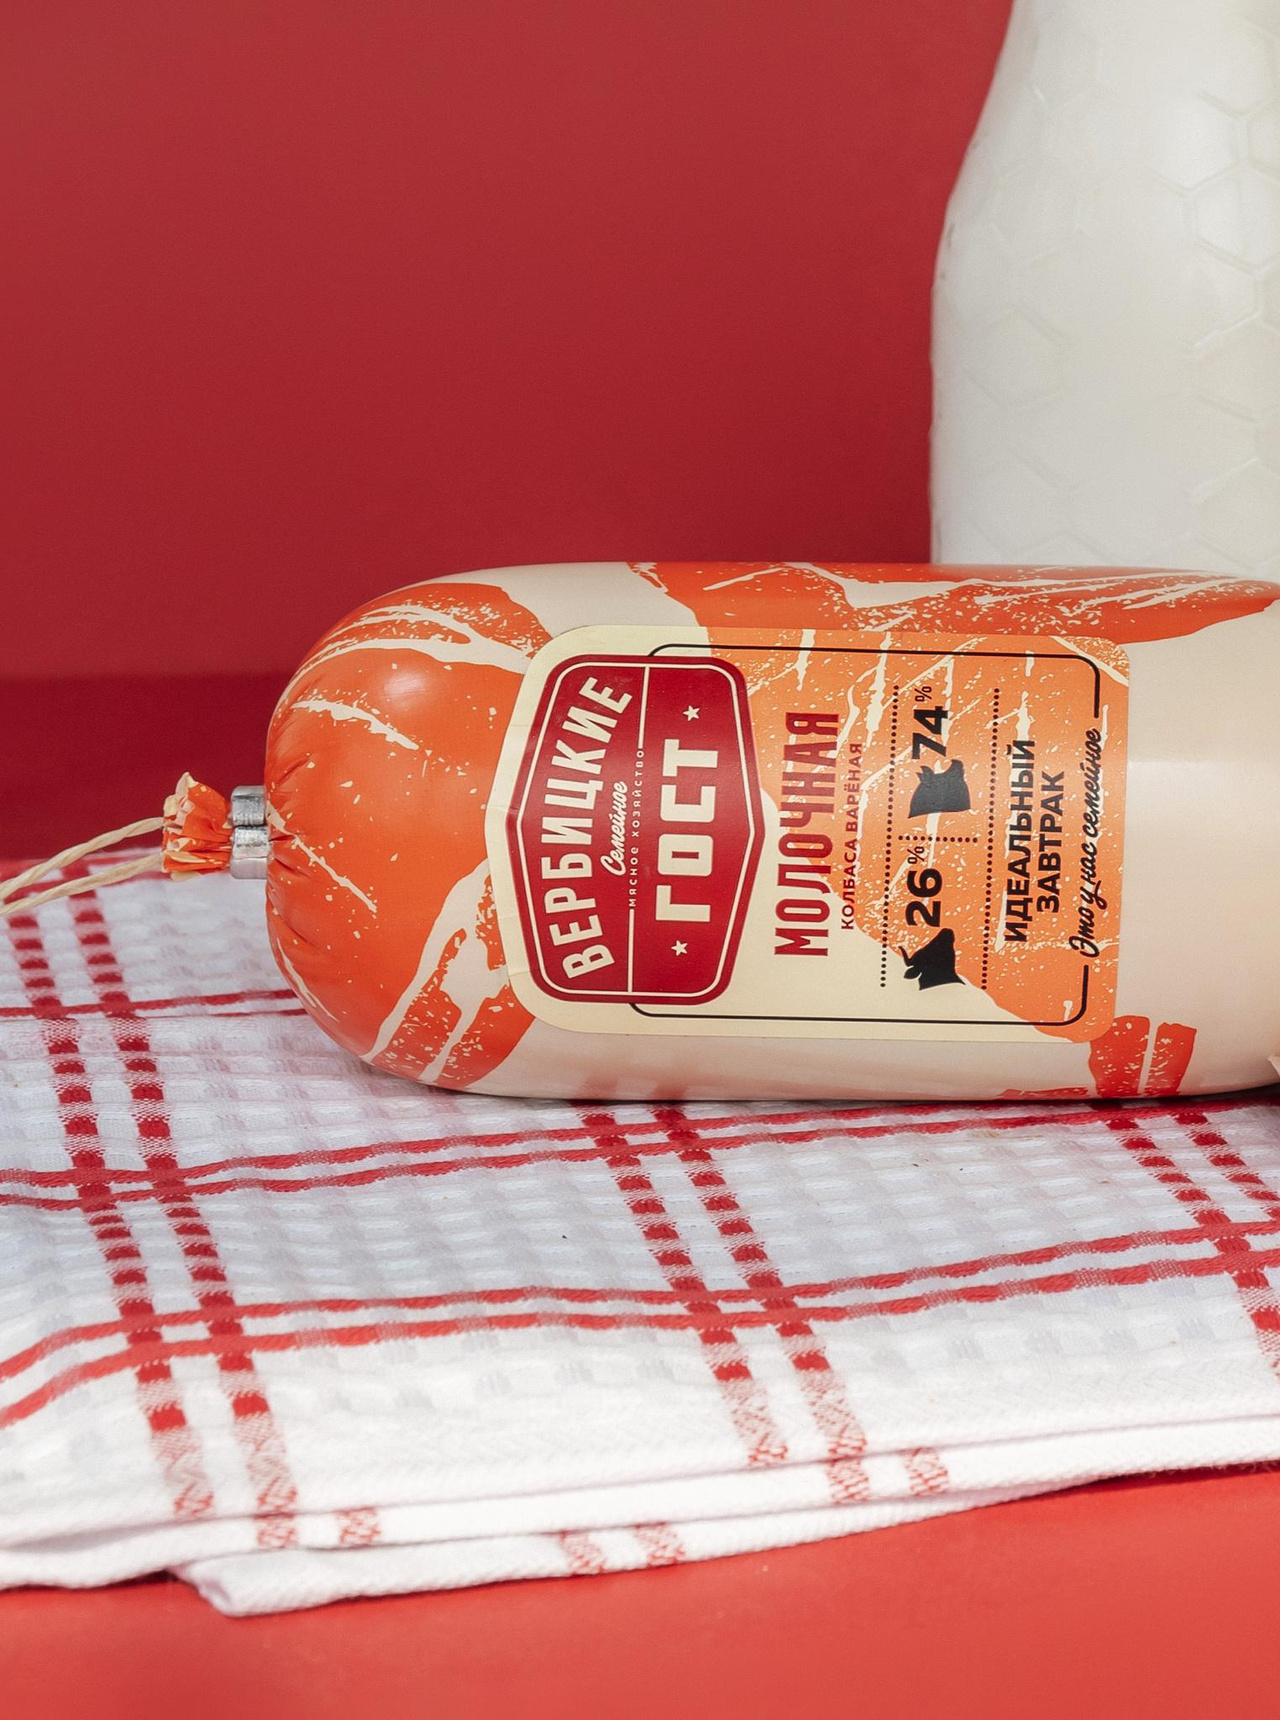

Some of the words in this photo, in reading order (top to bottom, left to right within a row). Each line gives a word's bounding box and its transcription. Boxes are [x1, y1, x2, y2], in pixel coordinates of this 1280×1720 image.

[539, 677, 634, 979] ВЕРБИЦКИЕ
[600, 781, 628, 876] Семейное
[655, 738, 718, 923] ГОСТ
[843, 743, 862, 832] ВАРЁНАЯ
[1080, 729, 1101, 837] семейное
[774, 712, 838, 956] МОЛОЧНАЯ
[841, 839, 858, 930] КОЛБАСА
[1004, 740, 1035, 942] ИДЕАЛЬНЫЙ
[1037, 771, 1064, 913] ЗАВТРАК
[1081, 842, 1098, 885] нас
[1069, 908, 1099, 957] Это
[1082, 880, 1107, 909] у
